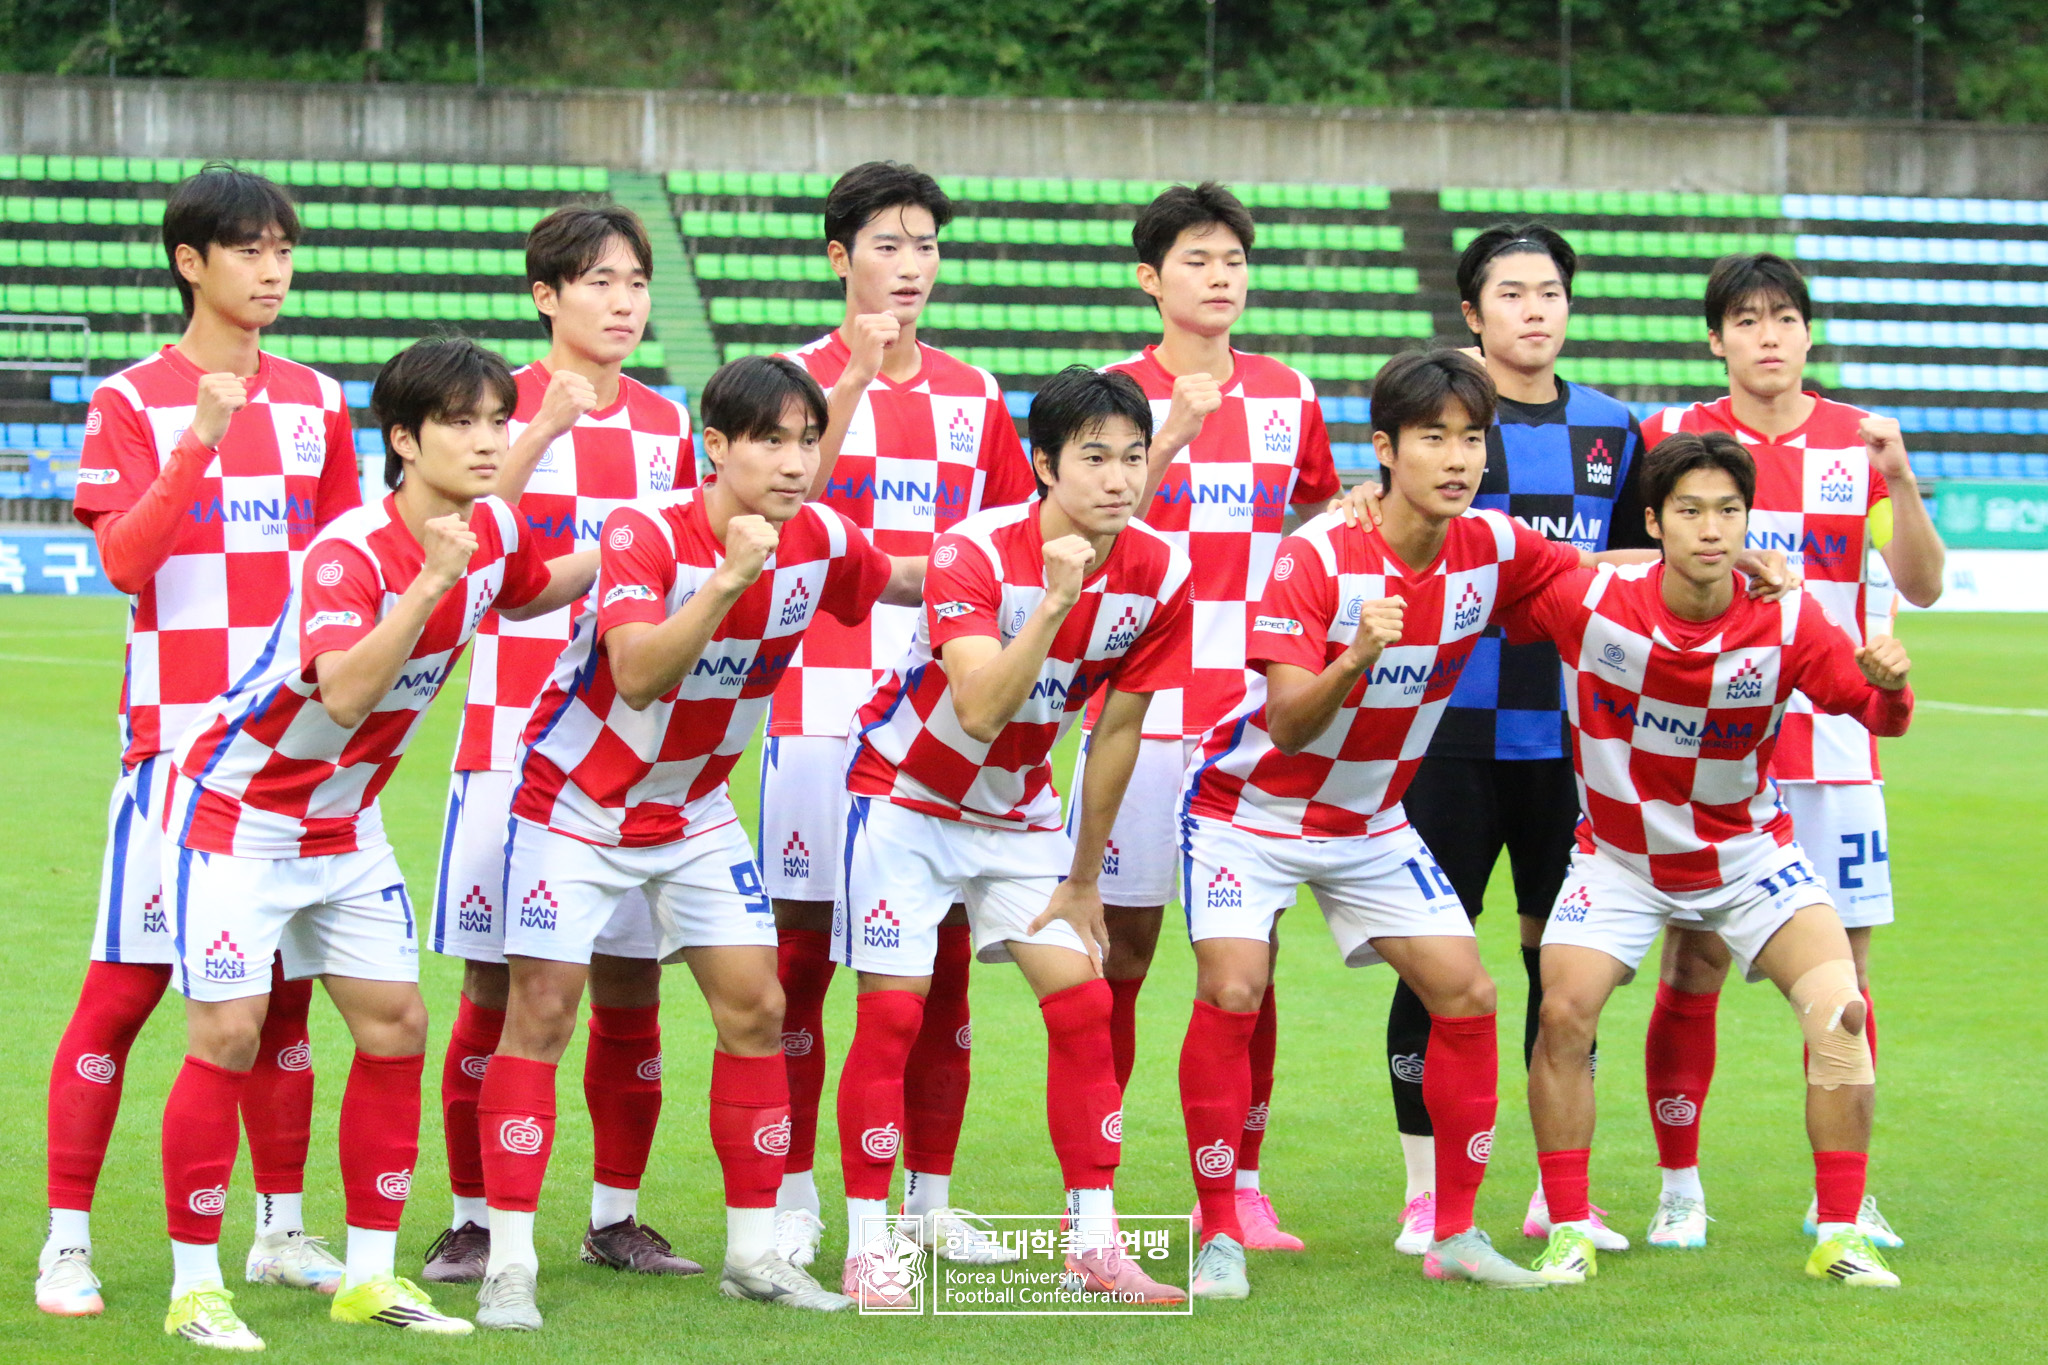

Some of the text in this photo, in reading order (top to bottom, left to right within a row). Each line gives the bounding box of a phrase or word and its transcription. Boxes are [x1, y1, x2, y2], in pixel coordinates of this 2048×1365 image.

[950, 431, 974, 443] HAN
[1265, 432, 1291, 443] HAN
[295, 441, 321, 453] HAN
[951, 441, 974, 454] NAM
[1266, 442, 1291, 453] NAM
[297, 452, 321, 463] NAM
[1586, 462, 1612, 474] HAN
[650, 470, 671, 482] HAN
[650, 480, 671, 492] NAM
[1821, 482, 1853, 492] HAN
[1821, 492, 1853, 503] NAM
[782, 601, 808, 616] HAN
[1455, 605, 1481, 620] HAN
[779, 610, 806, 626] NAM
[1454, 614, 1480, 631] NAM
[1728, 681, 1762, 692] HAN
[1726, 689, 1761, 700] NAM
[1593, 692, 1753, 739] HANNAM
[784, 855, 809, 868] HAN
[784, 866, 809, 879] NAM
[729, 860, 770, 914] 9
[1208, 887, 1242, 898] HAN
[1207, 896, 1242, 908] NAM
[380, 882, 414, 939] 7
[522, 905, 557, 920] HAN
[1557, 903, 1587, 916] HAN
[460, 909, 492, 923] HAN
[1554, 912, 1586, 923] NAM
[459, 919, 491, 934] NAM
[520, 917, 556, 931] NAM
[864, 923, 900, 937] HAN
[864, 935, 899, 948] NAM
[206, 958, 245, 970] HAN
[206, 968, 245, 979] NAM
